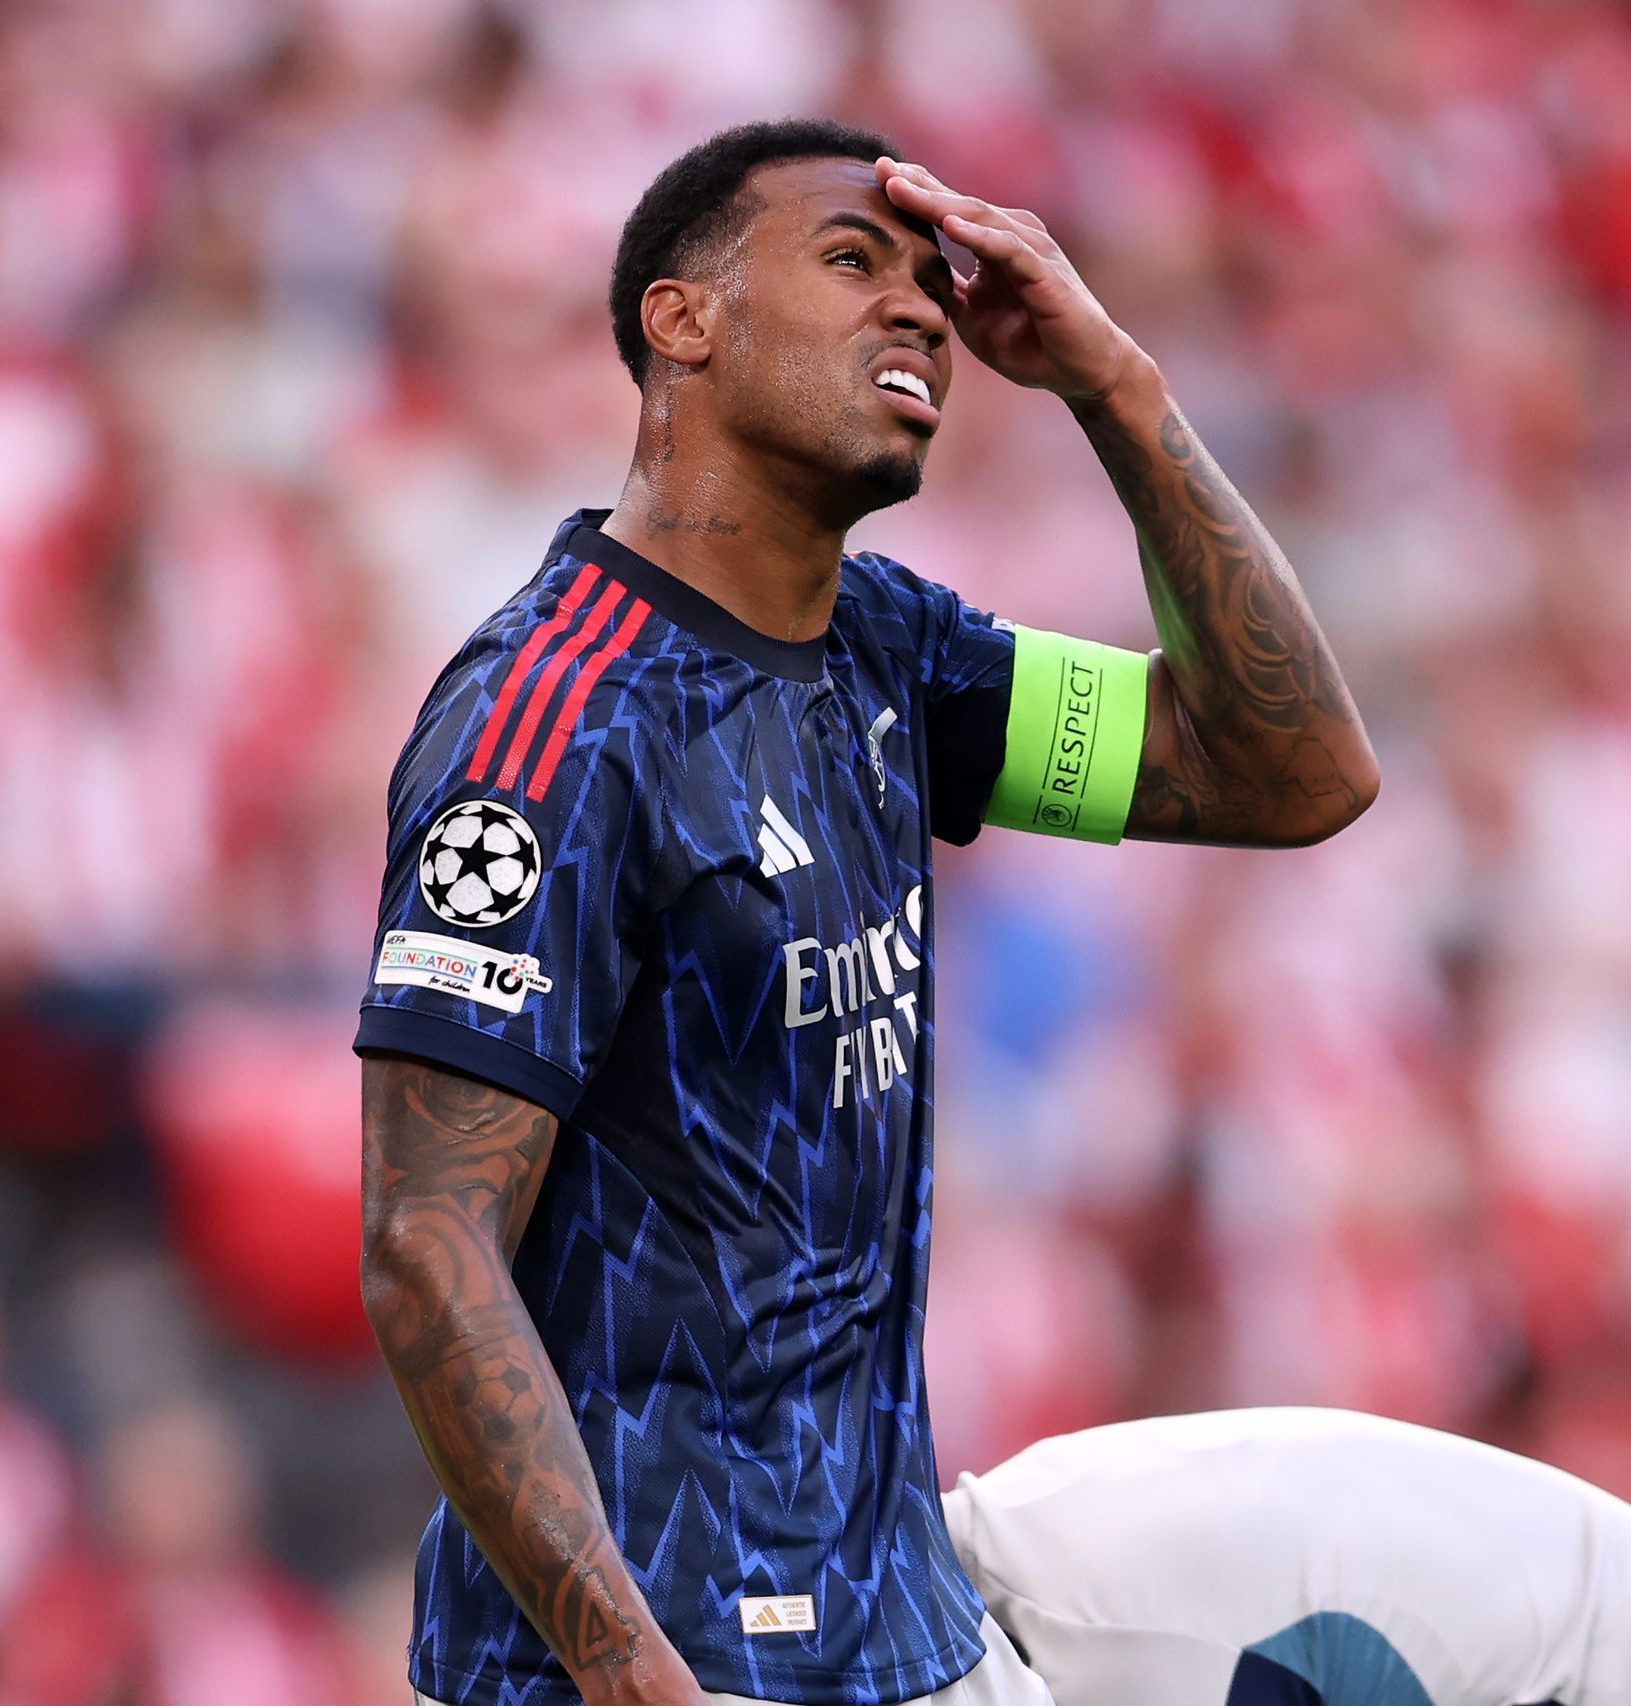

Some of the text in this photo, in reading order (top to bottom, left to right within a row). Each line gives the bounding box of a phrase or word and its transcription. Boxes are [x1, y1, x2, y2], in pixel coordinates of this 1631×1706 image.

[1052, 661, 1093, 794] RESPECT
[383, 951, 477, 978] FOUNDATION
[482, 960, 547, 995] 10 YEARS
[429, 976, 471, 993] for children
